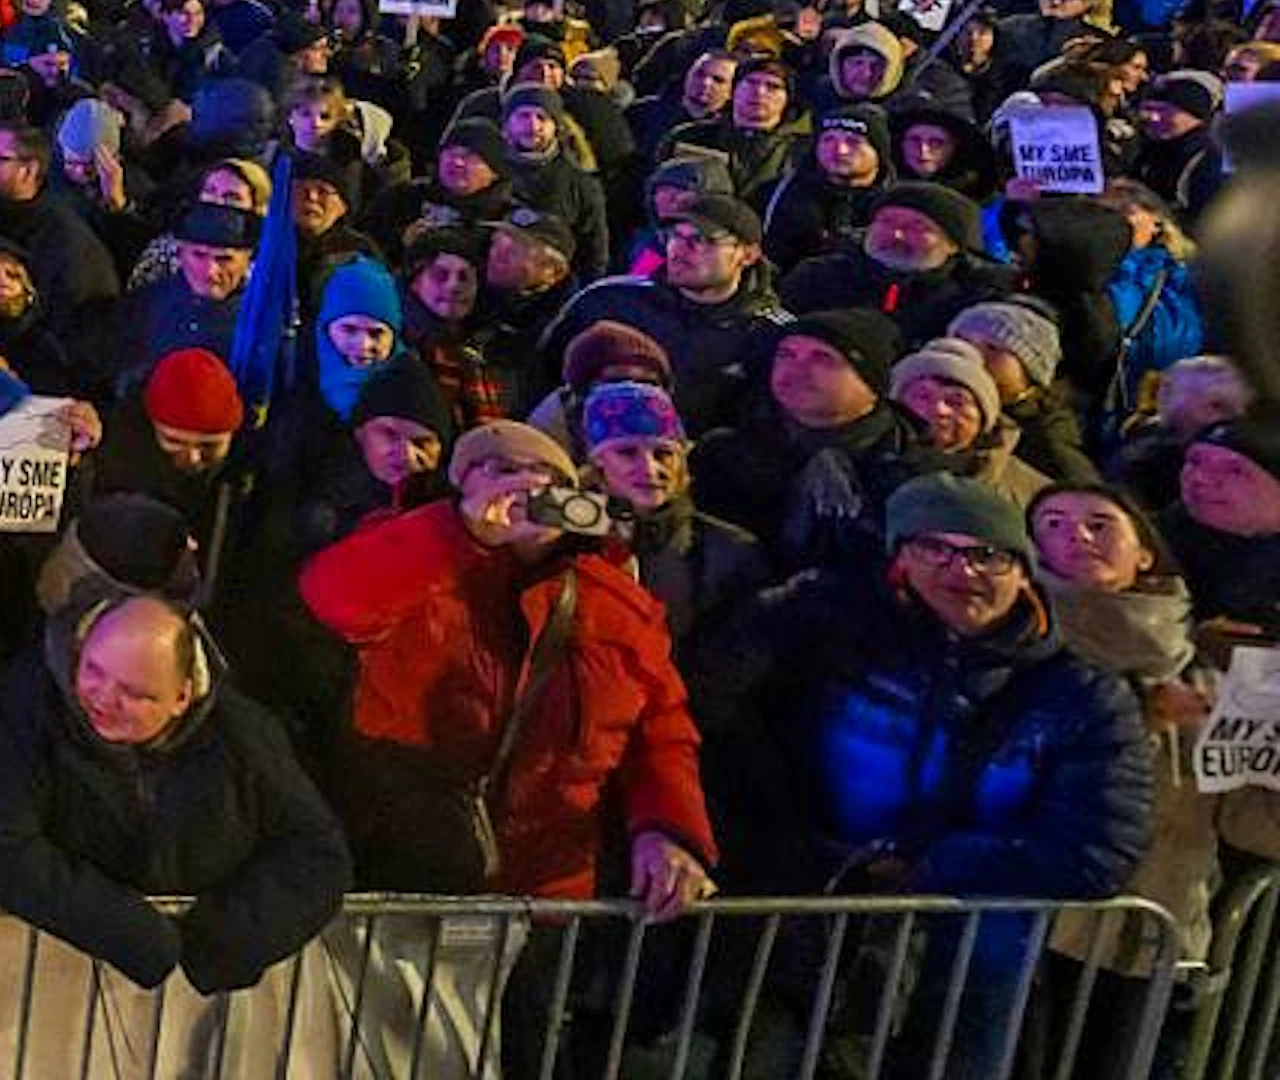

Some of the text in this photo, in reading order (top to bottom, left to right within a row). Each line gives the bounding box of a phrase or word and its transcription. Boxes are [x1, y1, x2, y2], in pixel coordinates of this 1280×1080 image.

[1020, 143, 1095, 163] MY SME
[19, 459, 62, 488] SME
[1209, 719, 1254, 741] MY
